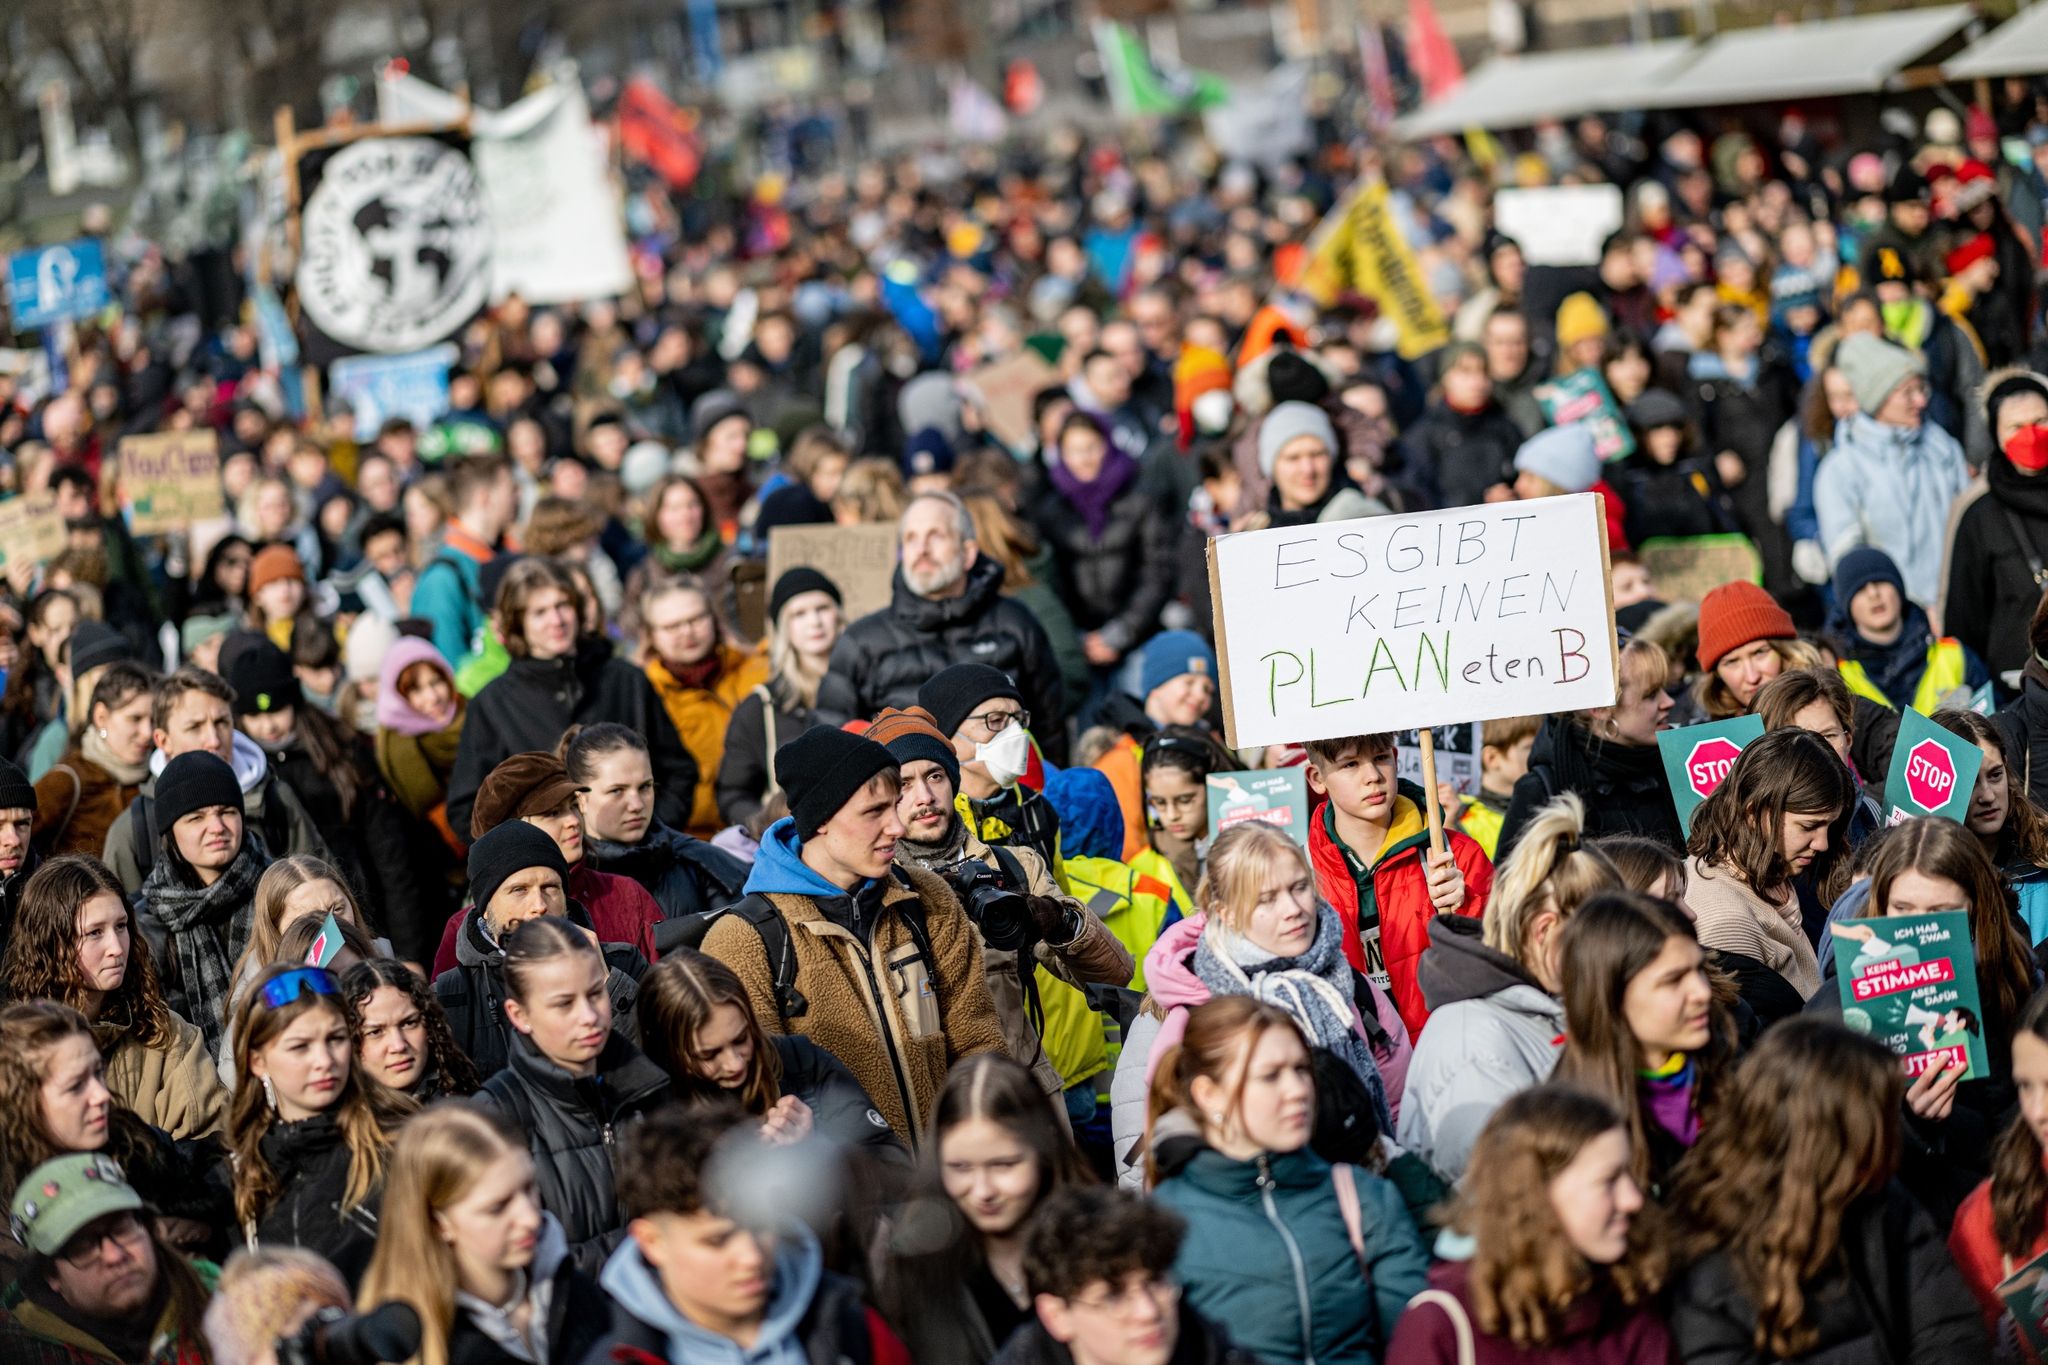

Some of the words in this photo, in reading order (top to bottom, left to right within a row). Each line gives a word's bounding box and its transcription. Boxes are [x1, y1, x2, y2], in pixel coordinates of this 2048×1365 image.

[1346, 569, 1578, 634] KEINEN
[1260, 629, 1544, 718] PLANeten
[1551, 628, 1591, 685] B
[1693, 756, 1738, 785] STO
[1910, 755, 1951, 792] STOP
[1894, 926, 1914, 940] ICH
[1915, 922, 1939, 936] HAB
[1919, 929, 1950, 945] ZWAR
[1866, 959, 1899, 977] KEINE
[1856, 962, 1949, 997] STIMME,
[1911, 985, 1938, 999] ABER
[1924, 989, 1959, 1008] DAFÜR
[1890, 1032, 1909, 1045] ICH
